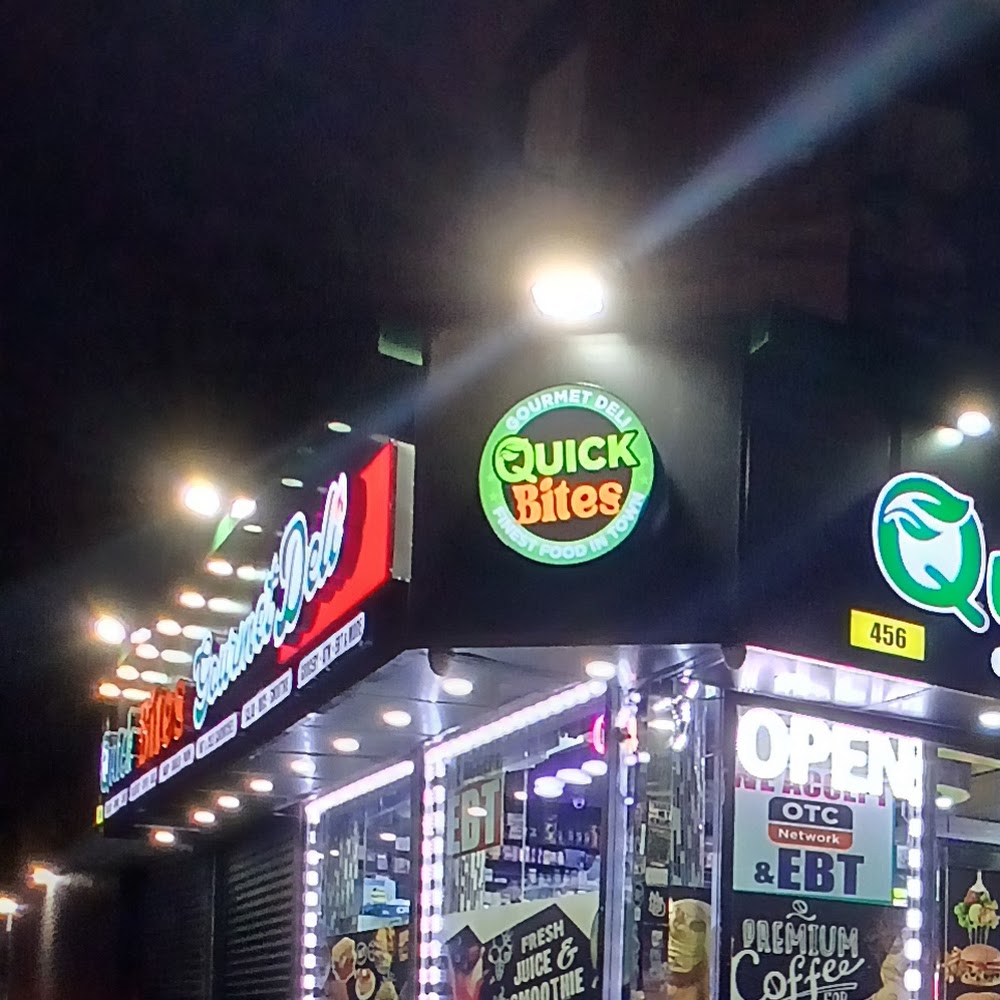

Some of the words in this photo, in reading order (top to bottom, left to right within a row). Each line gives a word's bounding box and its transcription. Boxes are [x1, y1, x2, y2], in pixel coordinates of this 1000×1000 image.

[505, 389, 593, 431] GOURMET
[594, 395, 632, 428] DELI
[495, 431, 639, 483] QUICK
[511, 477, 623, 525] Bites
[493, 505, 538, 551] FINEST
[538, 543, 587, 559] FOOD
[589, 536, 609, 552] IN
[609, 491, 645, 539] TOWN
[273, 472, 348, 648] Deli
[870, 622, 907, 649] 456
[736, 707, 920, 804] OPEN
[446, 779, 500, 856] EBT
[778, 827, 840, 845] Network
[782, 801, 839, 825] OTC
[754, 861, 774, 885] &
[777, 848, 864, 895] EBT
[521, 919, 565, 954] FRESH
[742, 918, 859, 958] PREMIUM
[513, 948, 552, 986] JUICE
[556, 936, 579, 970] &
